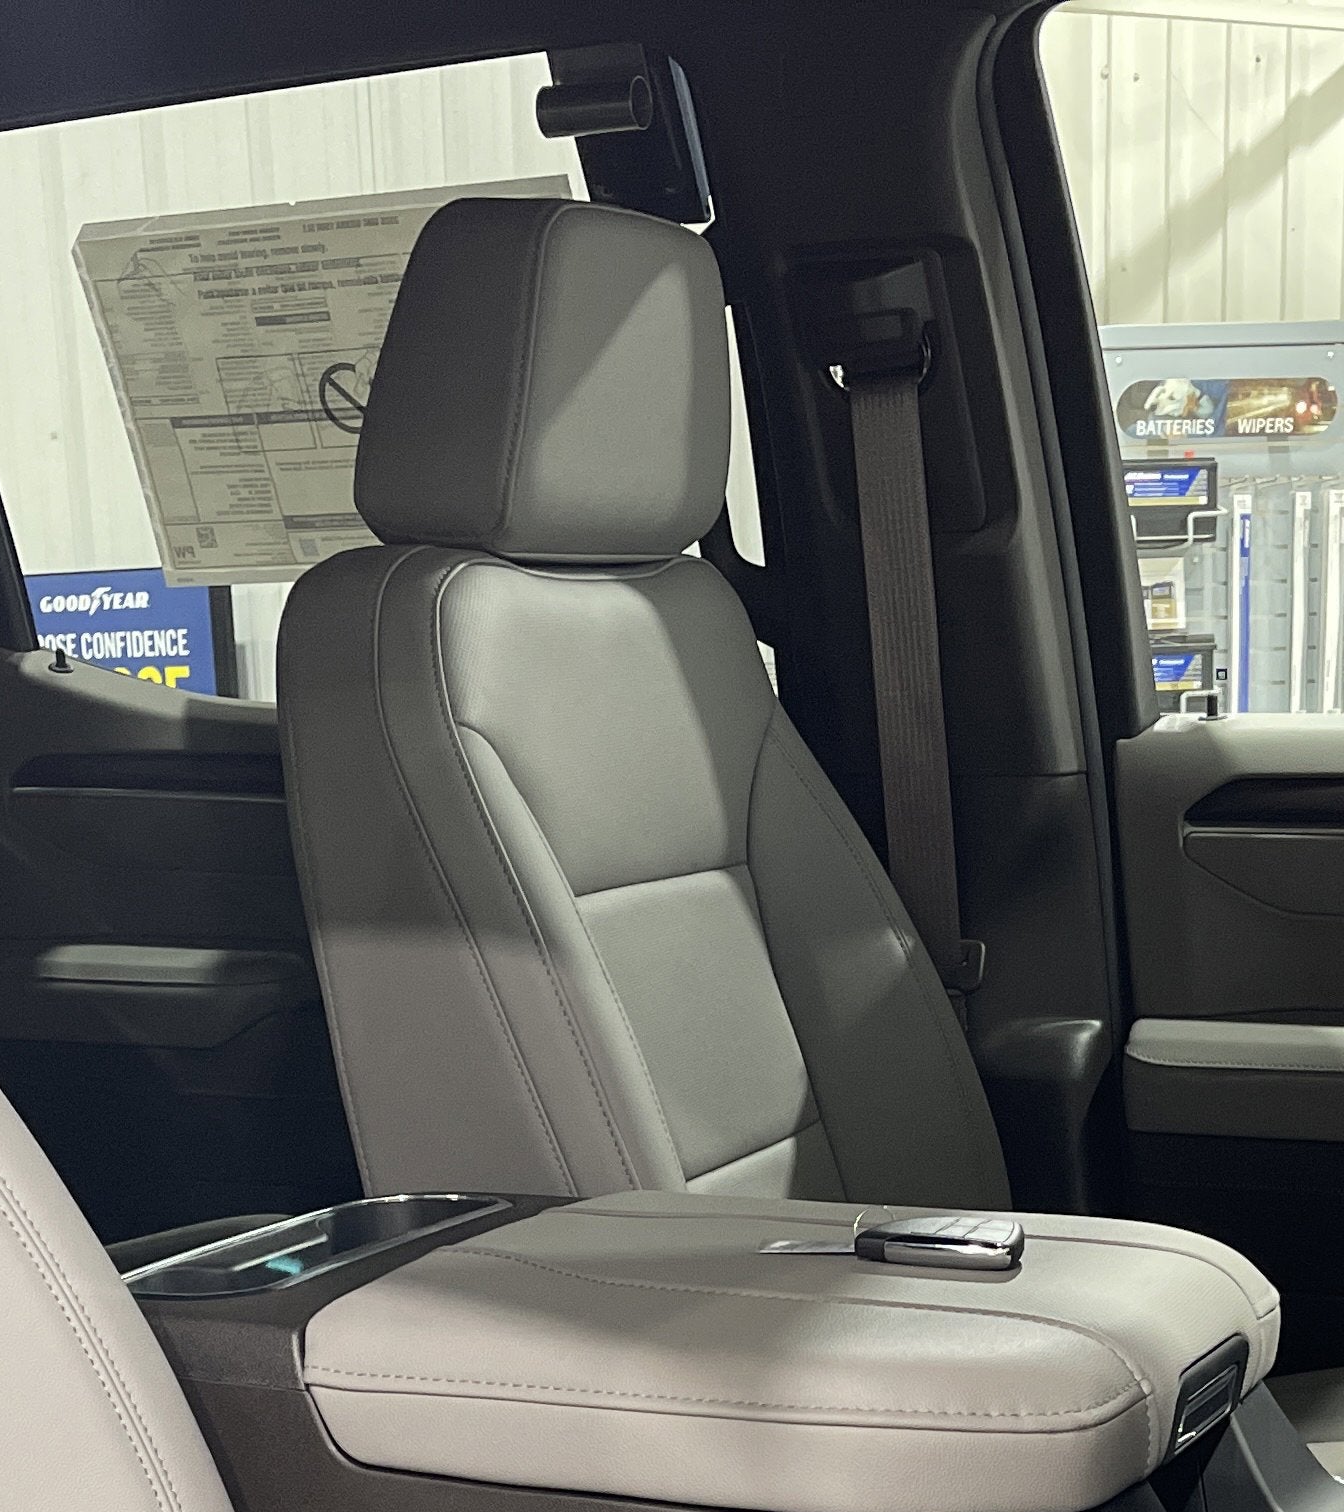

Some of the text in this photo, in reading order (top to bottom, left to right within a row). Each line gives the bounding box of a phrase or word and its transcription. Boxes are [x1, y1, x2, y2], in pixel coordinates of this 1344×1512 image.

[1135, 417, 1294, 436] BATTERIES WIPERS
[40, 586, 150, 617] GOODYEAR
[80, 628, 191, 660] CONFIDENCE
